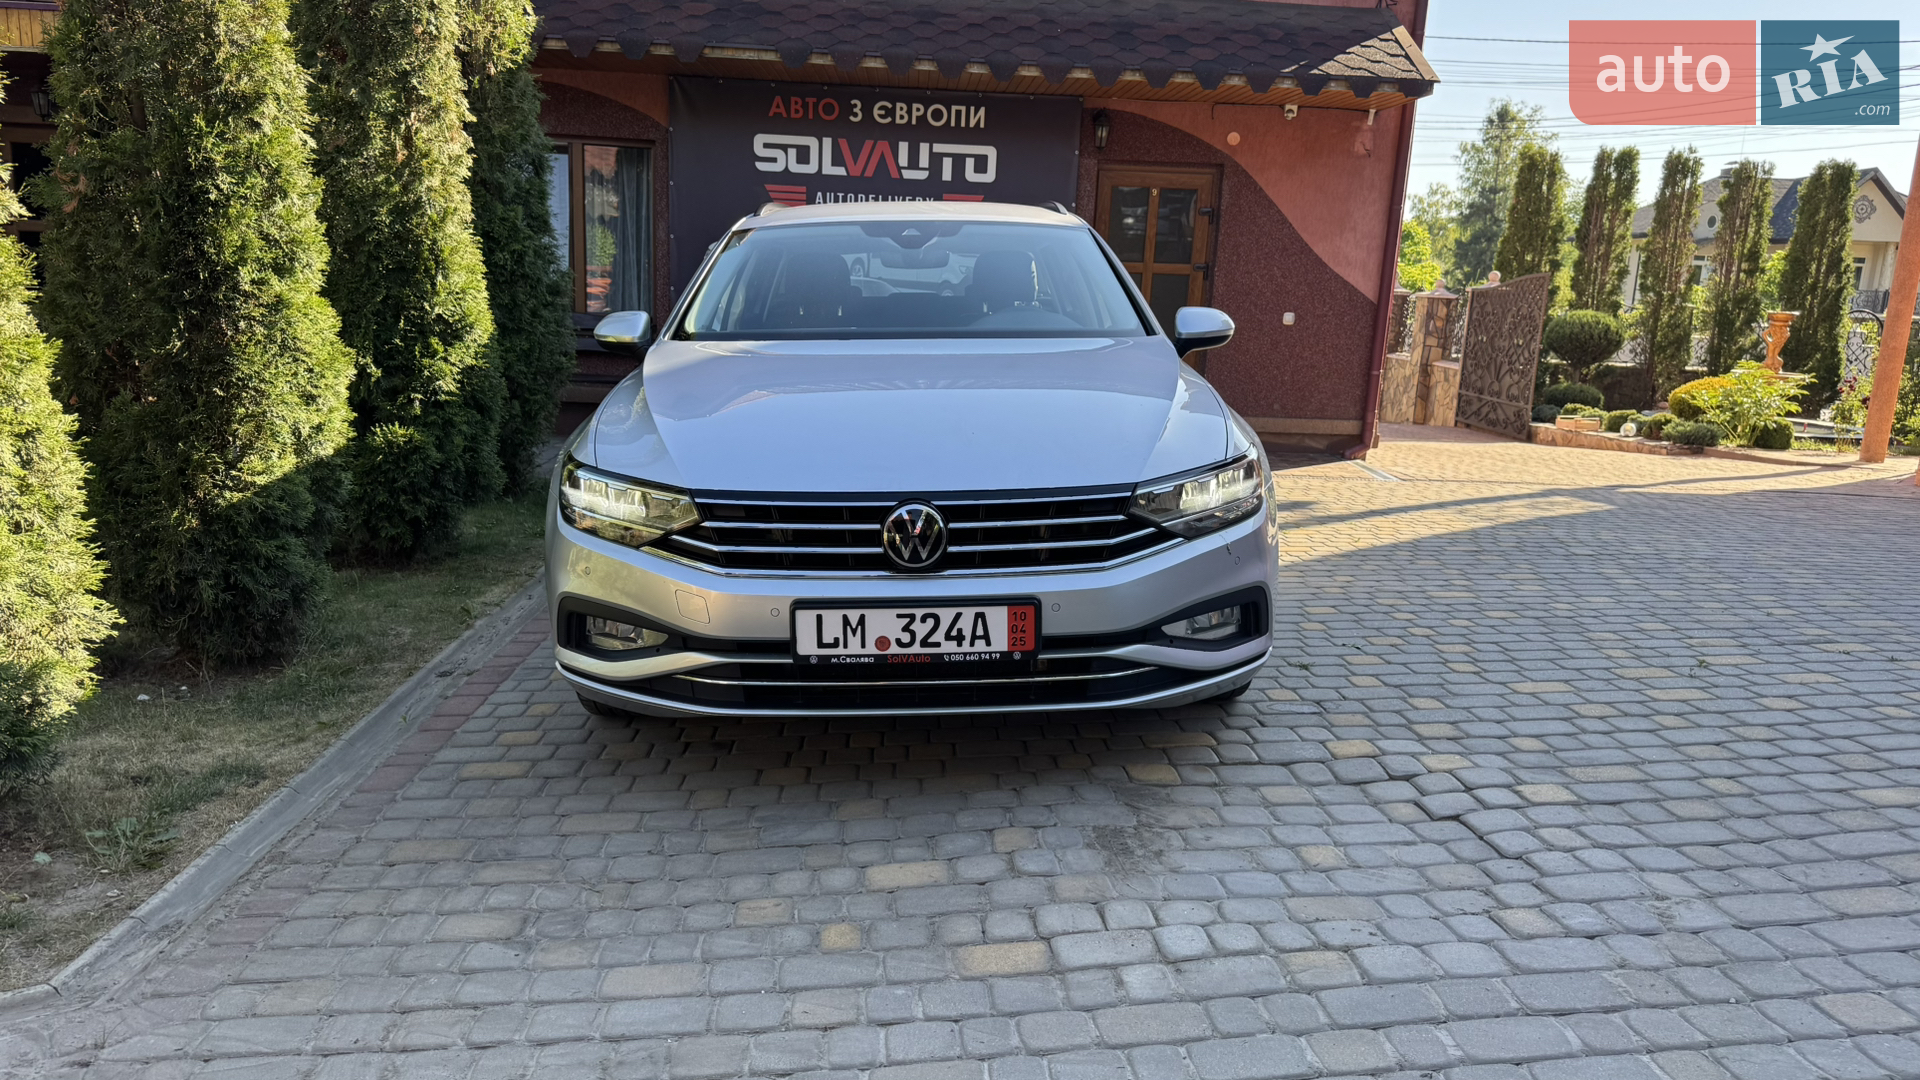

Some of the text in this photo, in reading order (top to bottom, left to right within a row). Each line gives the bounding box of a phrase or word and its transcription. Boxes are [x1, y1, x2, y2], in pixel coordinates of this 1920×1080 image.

[768, 95, 840, 121] АВТО
[872, 101, 986, 128] ЄВРОПИ
[753, 133, 998, 183] SOLVAUTO
[1011, 611, 1027, 622] 10
[816, 611, 992, 649] LM 324A
[1011, 623, 1027, 634] 04
[1011, 636, 1027, 647] 25
